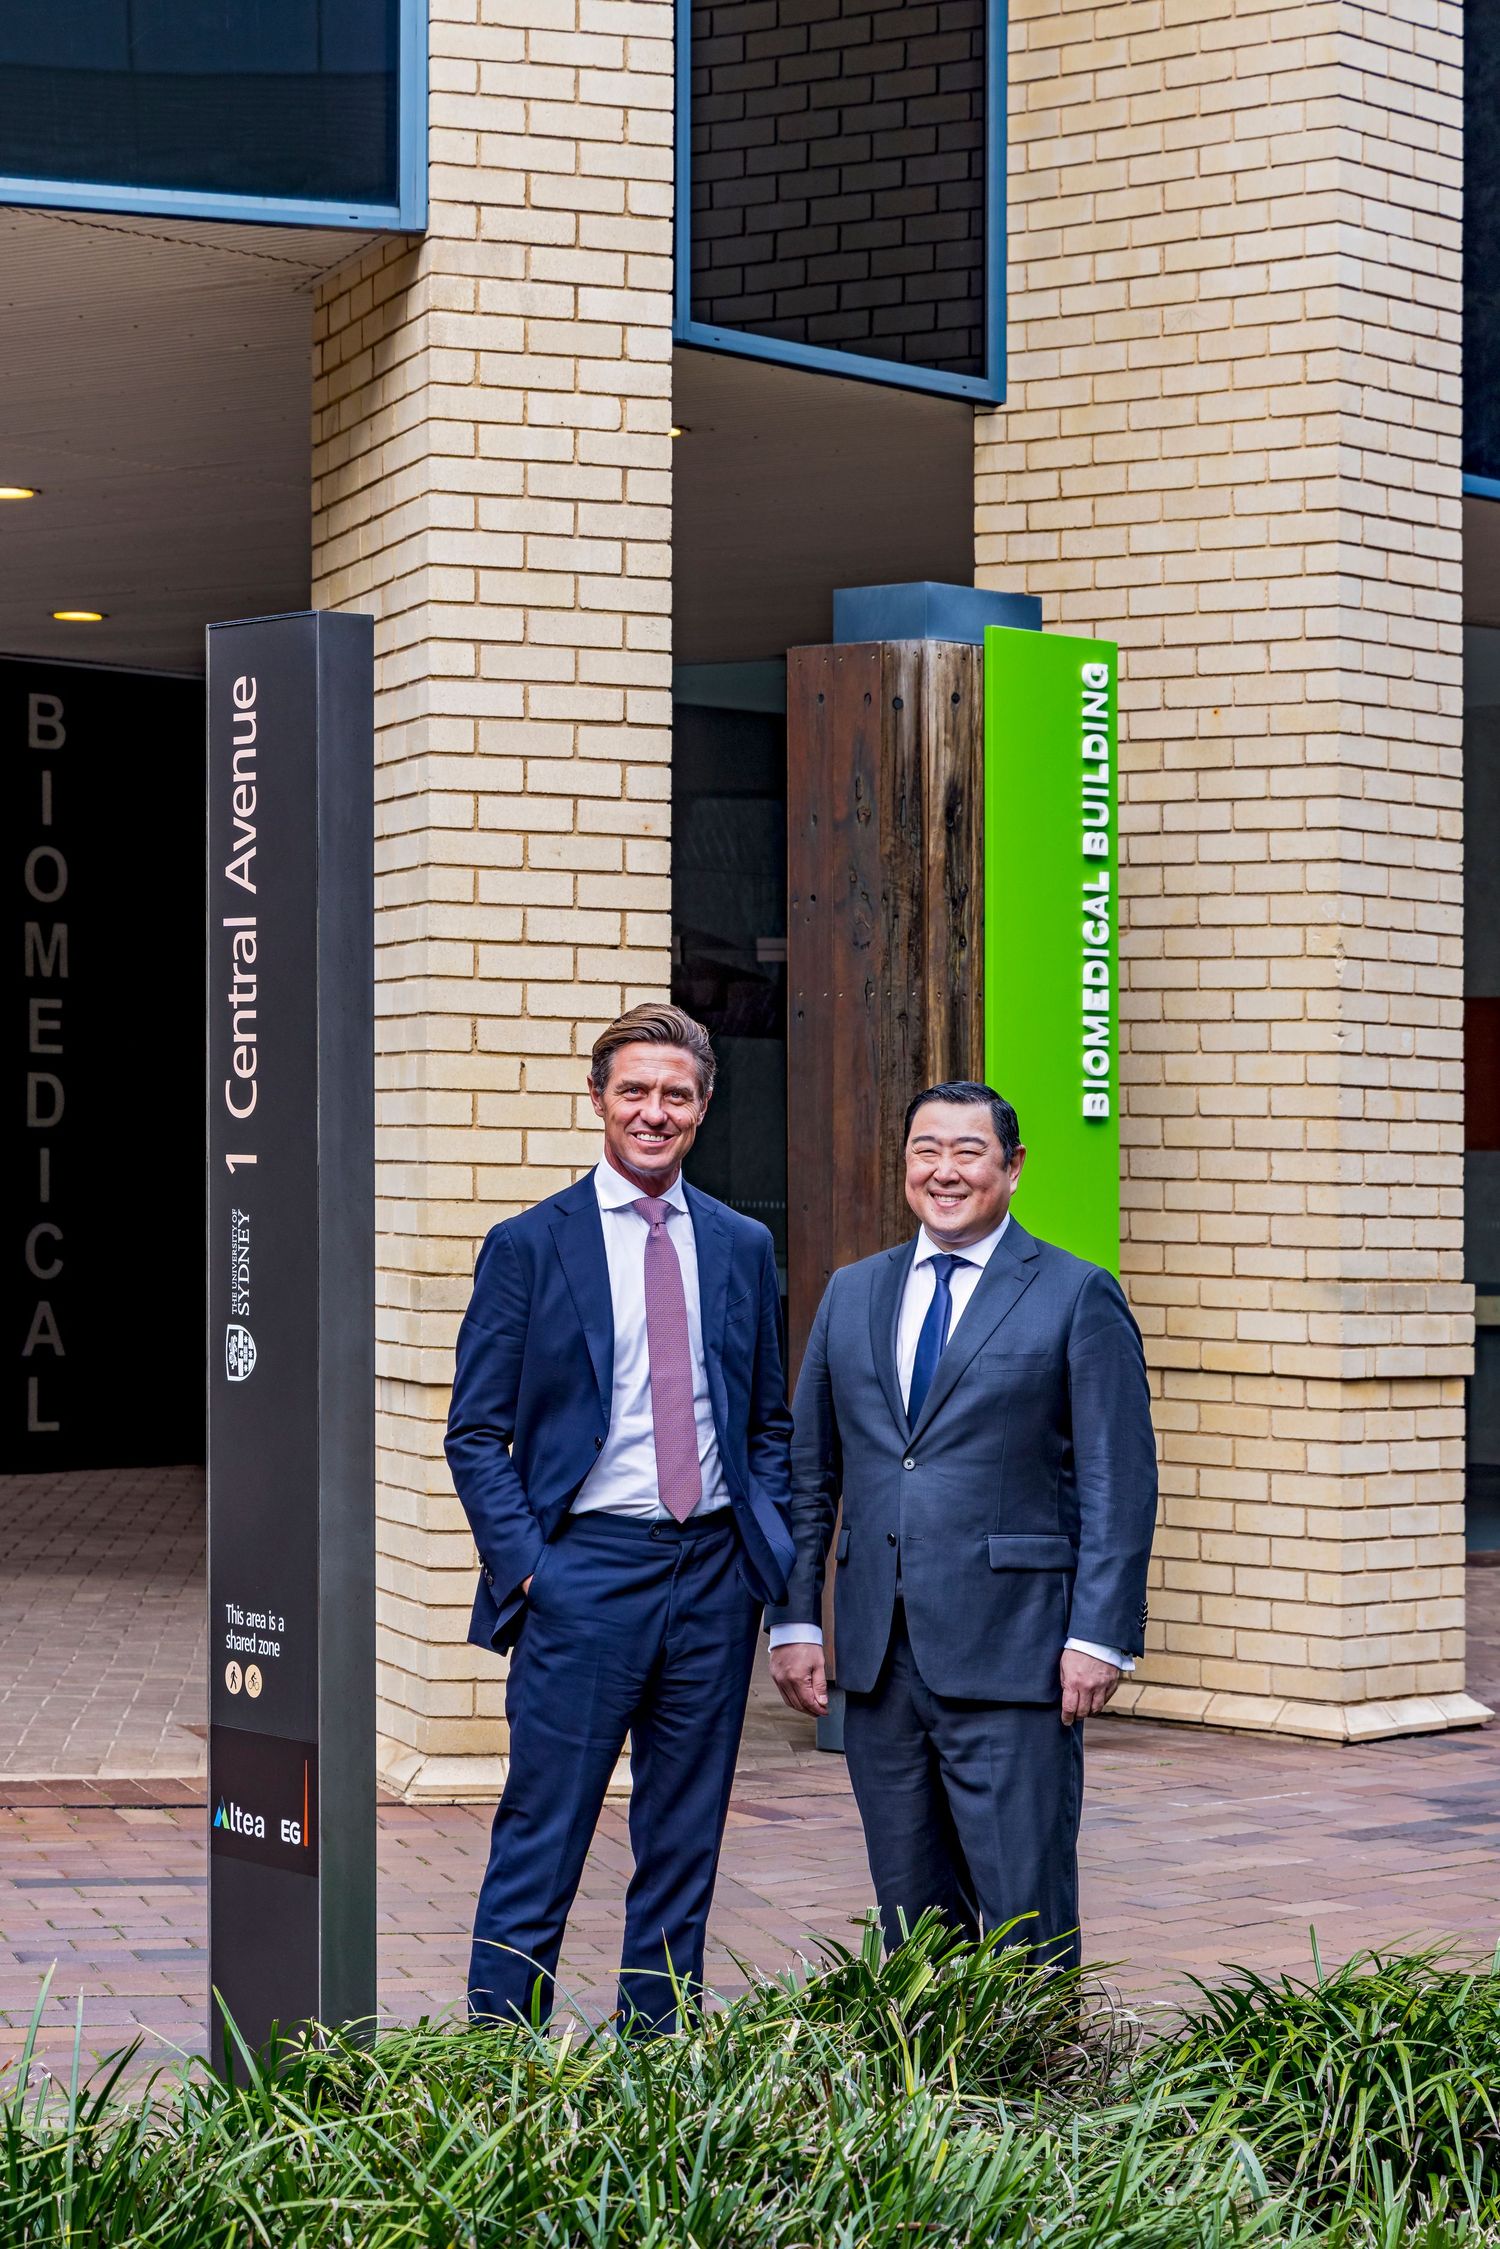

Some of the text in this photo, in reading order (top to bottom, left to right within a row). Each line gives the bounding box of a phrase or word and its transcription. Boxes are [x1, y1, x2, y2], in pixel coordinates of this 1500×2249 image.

[1082, 662, 1110, 1118] BIOMEDICAL BUILDING
[223, 675, 258, 1175] 1 Central Avenue
[23, 693, 68, 1433] BIOMEDICAL
[231, 1208, 238, 1224] OF
[237, 1208, 250, 1316] SYDNEY
[225, 1603, 285, 1632] This area is a
[225, 1628, 281, 1658] shared zone
[213, 1797, 265, 1838] Altea
[280, 1818, 301, 1845] EG
